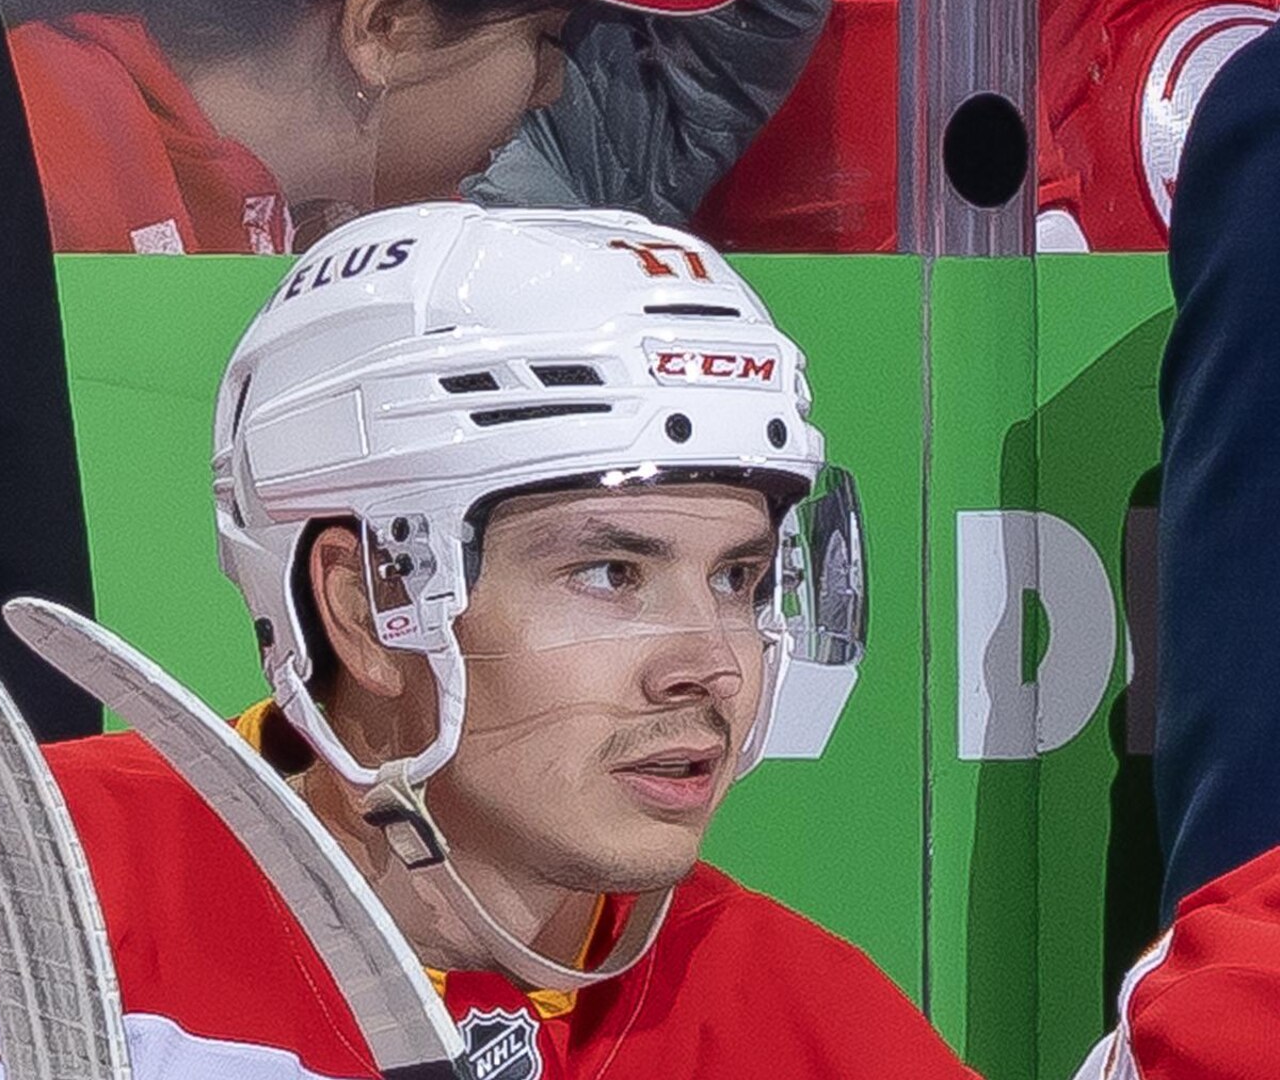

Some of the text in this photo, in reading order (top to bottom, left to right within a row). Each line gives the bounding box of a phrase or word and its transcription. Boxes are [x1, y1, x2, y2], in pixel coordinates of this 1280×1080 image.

[266, 237, 418, 314] ELUS
[608, 239, 714, 281] 17
[654, 351, 777, 381] CCM
[476, 1032, 523, 1079] NHL
